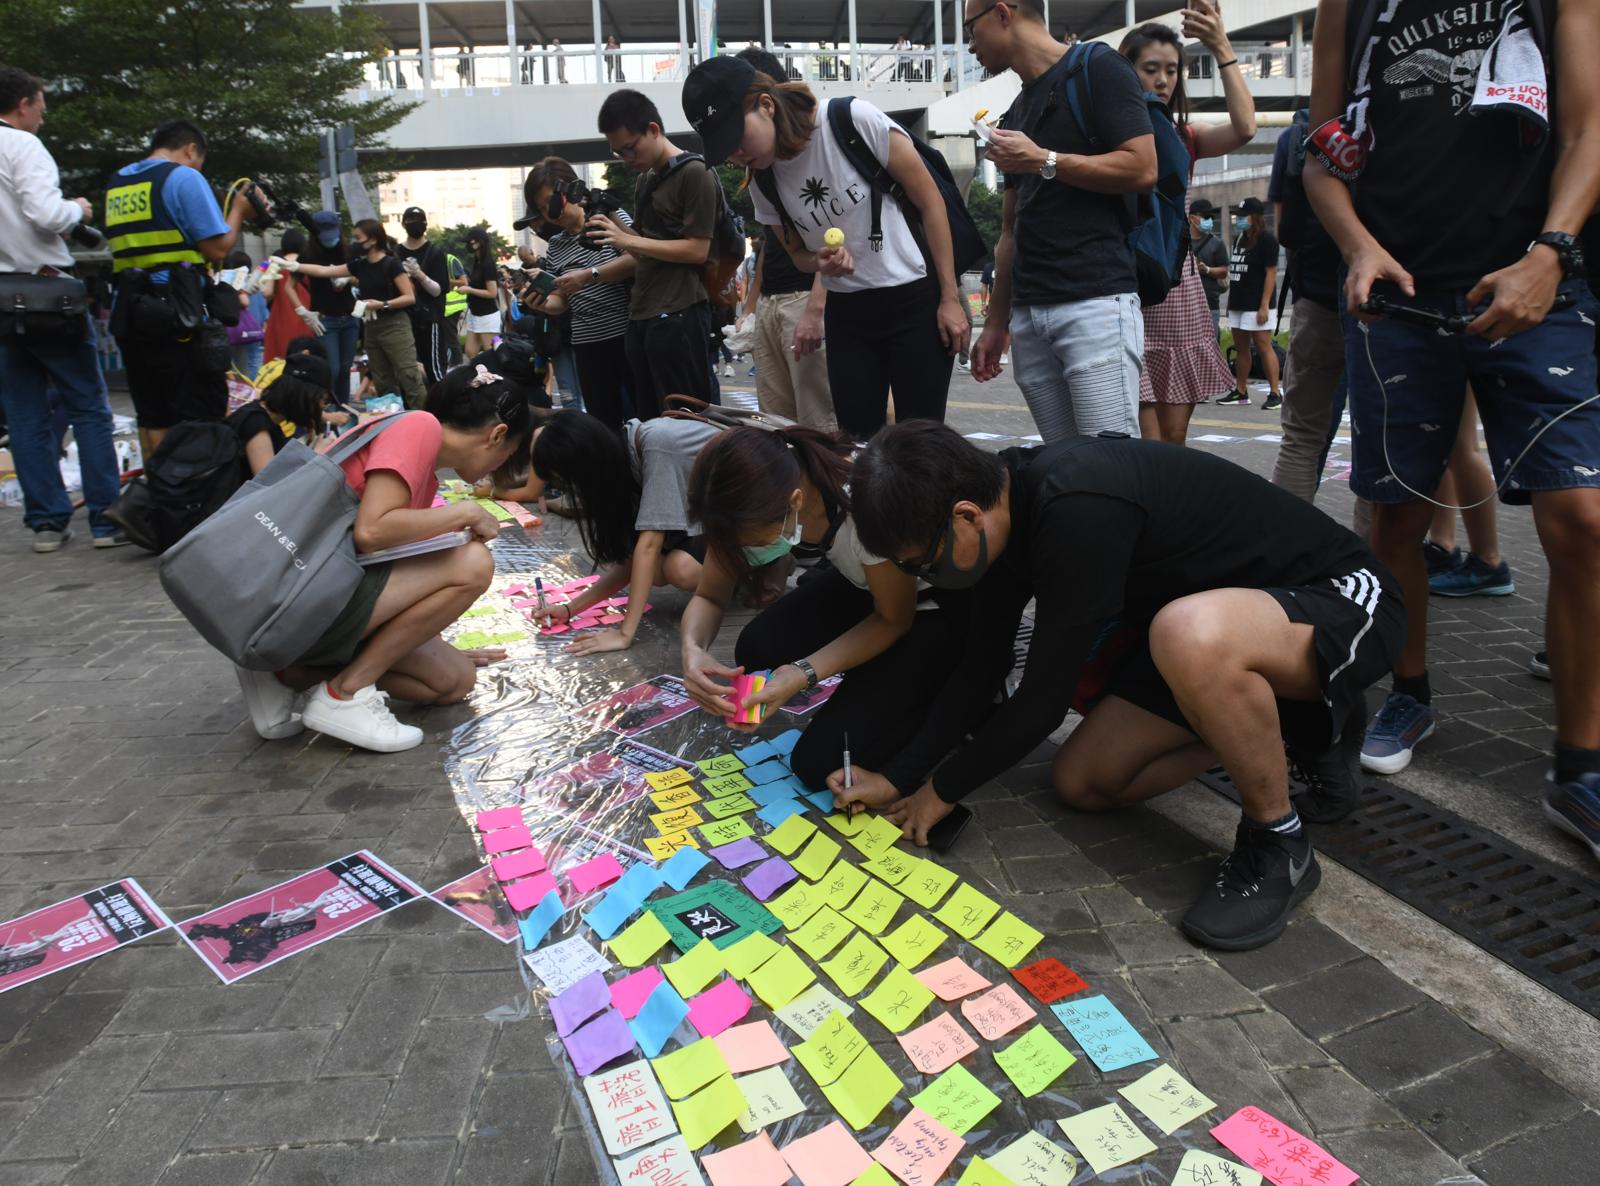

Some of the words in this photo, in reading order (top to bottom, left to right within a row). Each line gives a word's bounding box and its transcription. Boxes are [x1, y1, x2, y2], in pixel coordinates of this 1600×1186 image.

[1387, 0, 1505, 56] QUIKSIL
[108, 190, 147, 217] PRESS
[253, 511, 282, 537] DEAN
[888, 990, 912, 1015] 光
[1095, 1135, 1122, 1162] Fight
[1241, 1109, 1333, 1184] 香港人的血
